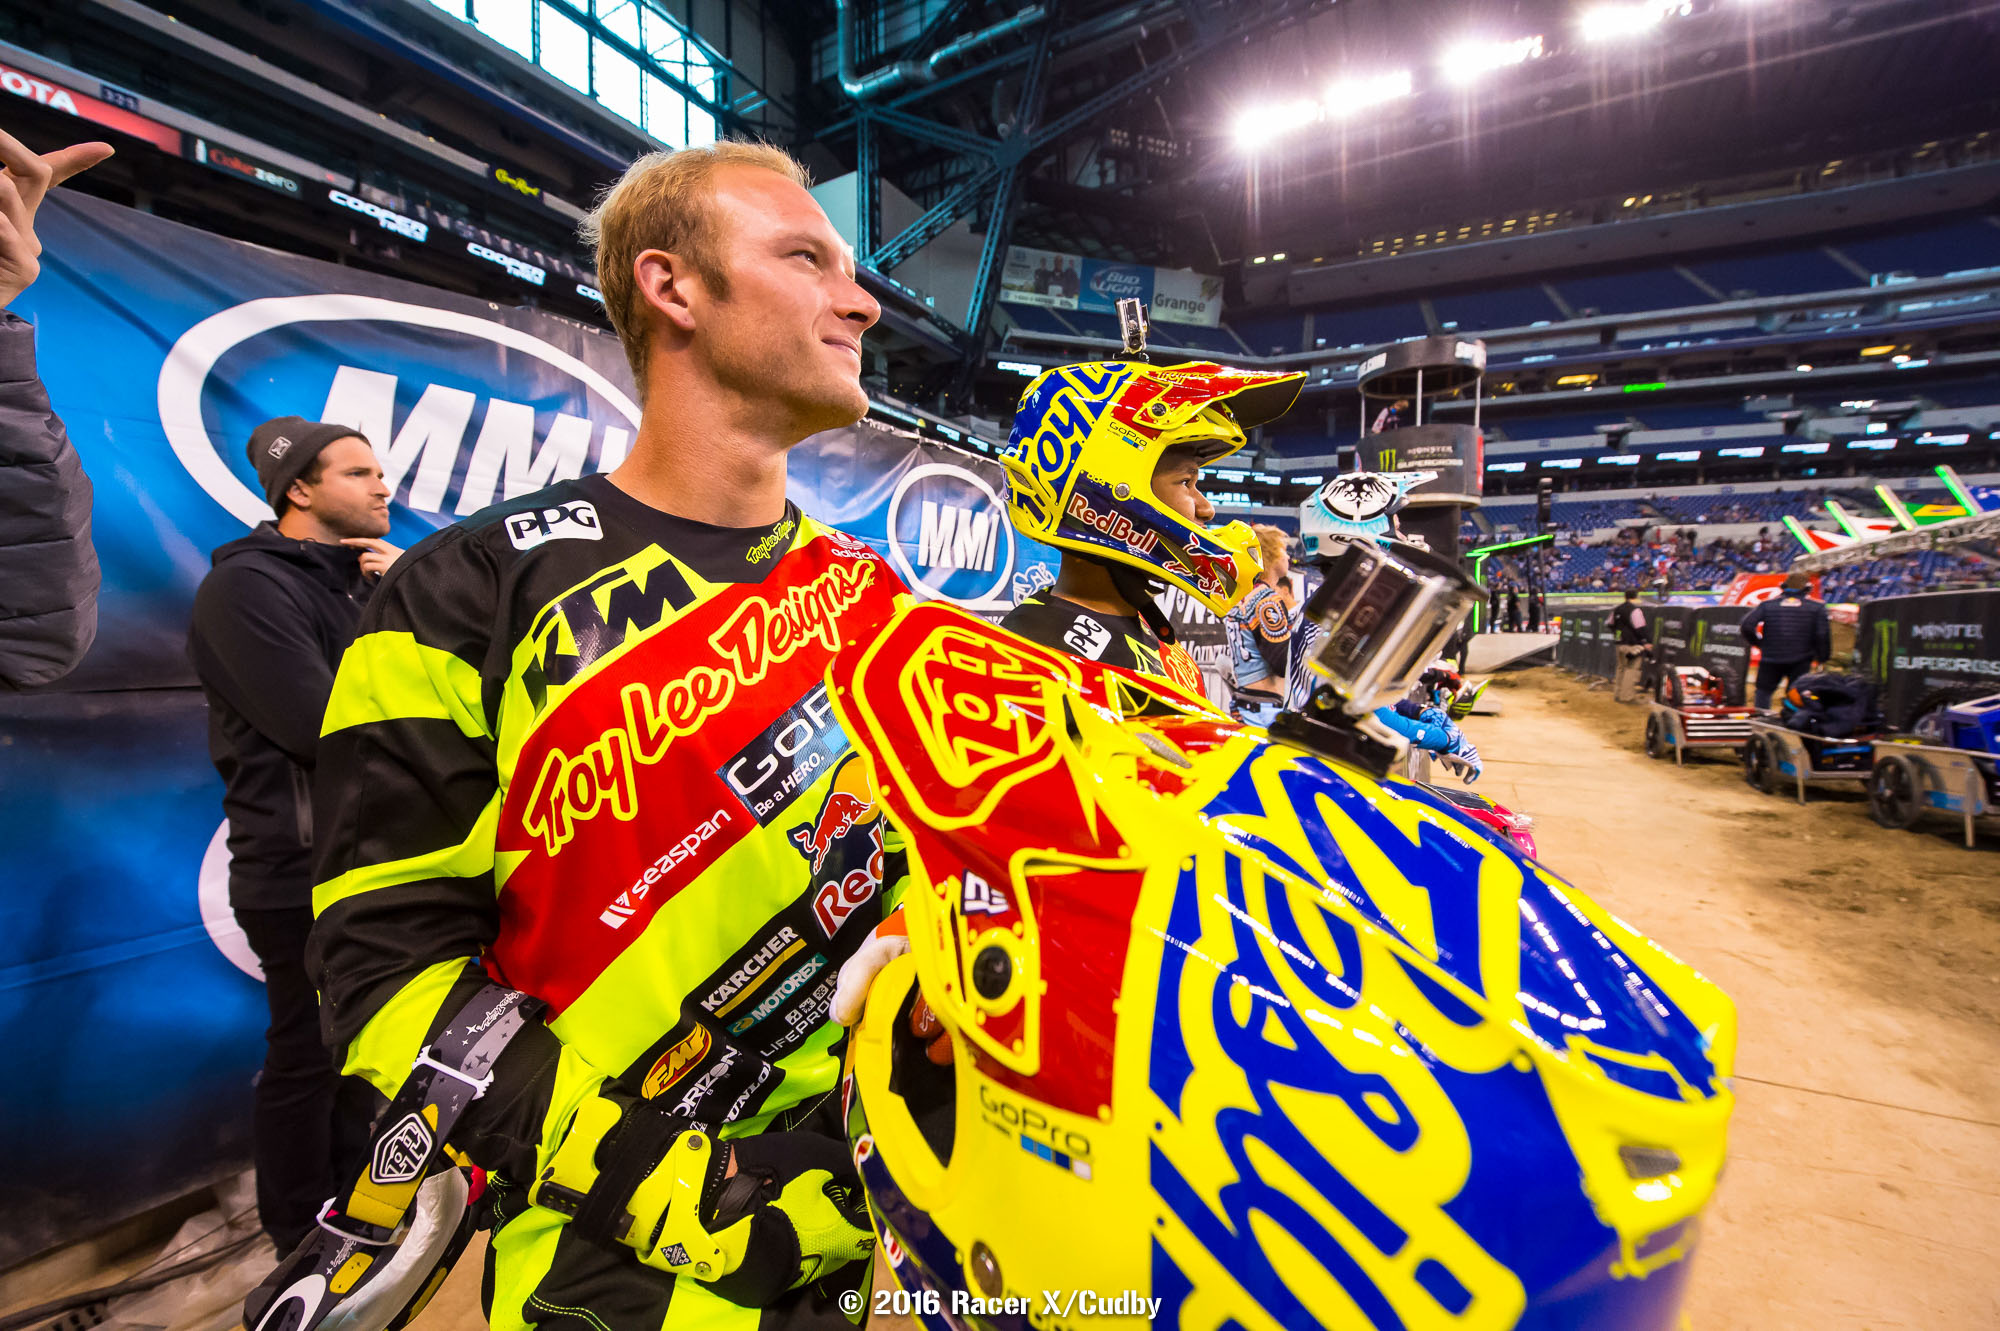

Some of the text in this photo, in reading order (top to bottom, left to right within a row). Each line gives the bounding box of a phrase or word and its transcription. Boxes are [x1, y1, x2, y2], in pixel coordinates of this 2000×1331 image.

[0, 67, 79, 116] OTA
[254, 167, 298, 192] zero
[329, 189, 429, 233] COOPER
[467, 241, 546, 279] COOPER
[1155, 293, 1206, 313] Grange
[1109, 421, 1148, 447] GoPro
[510, 505, 597, 540] PPG
[830, 548, 880, 560] adidas
[917, 500, 1000, 572] MMI
[1066, 491, 1160, 555] Red Bull
[521, 558, 698, 714] KTM
[1069, 617, 1103, 654] PPG
[522, 560, 876, 858] Troy Lee Designs
[754, 752, 825, 817] Be a HERO.
[632, 808, 732, 901] seaspan
[700, 926, 799, 1013] KÄRCHER
[751, 956, 825, 1022] MOTOREX
[643, 1022, 709, 1101] FMF
[671, 1044, 739, 1117] ORIZON
[979, 1084, 1092, 1156] GoPro
